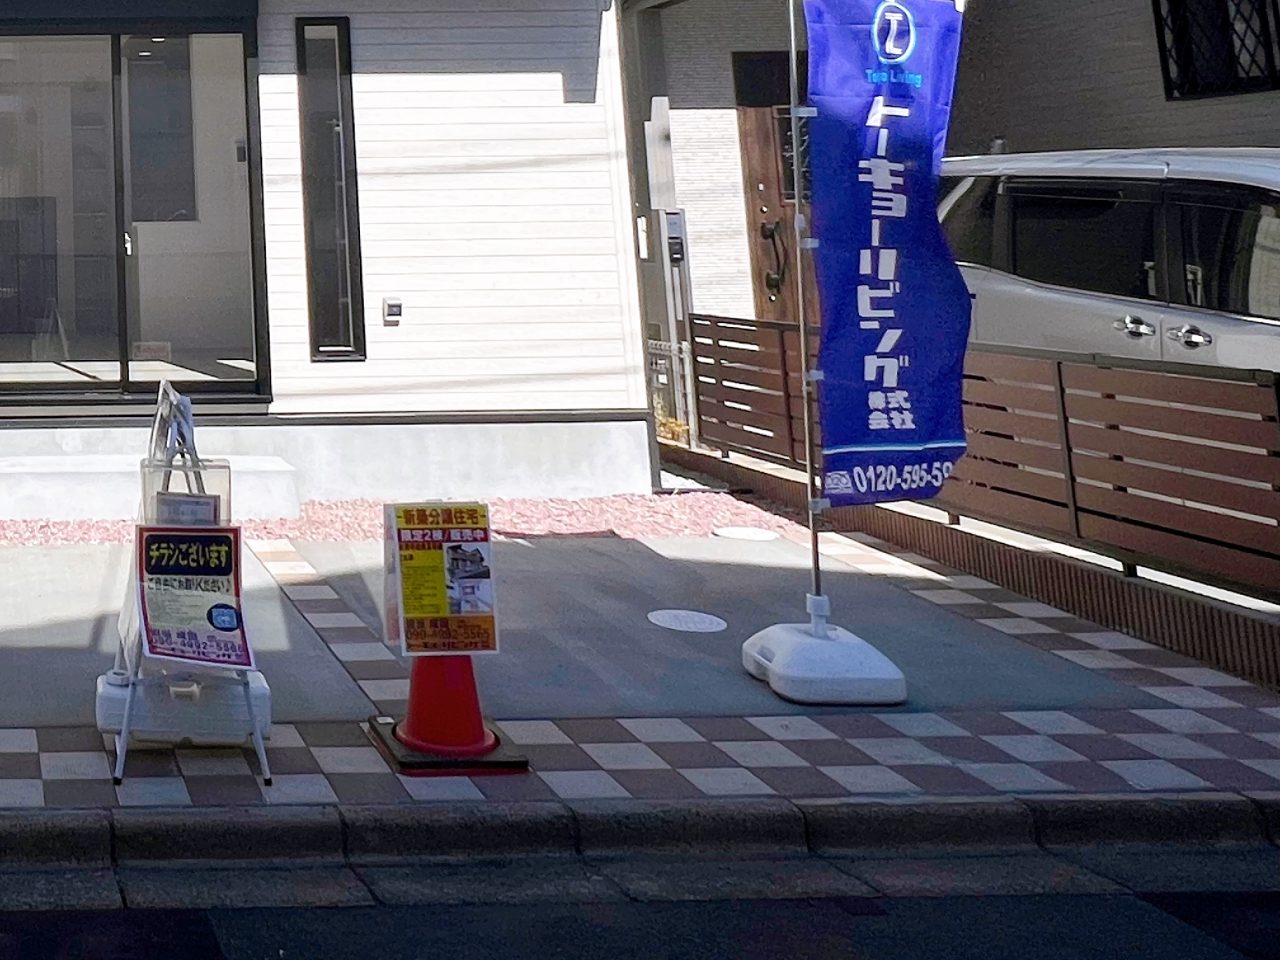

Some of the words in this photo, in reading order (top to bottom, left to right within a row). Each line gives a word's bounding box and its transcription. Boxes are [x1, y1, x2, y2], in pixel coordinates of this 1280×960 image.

[149, 542, 229, 568] チラシございます
